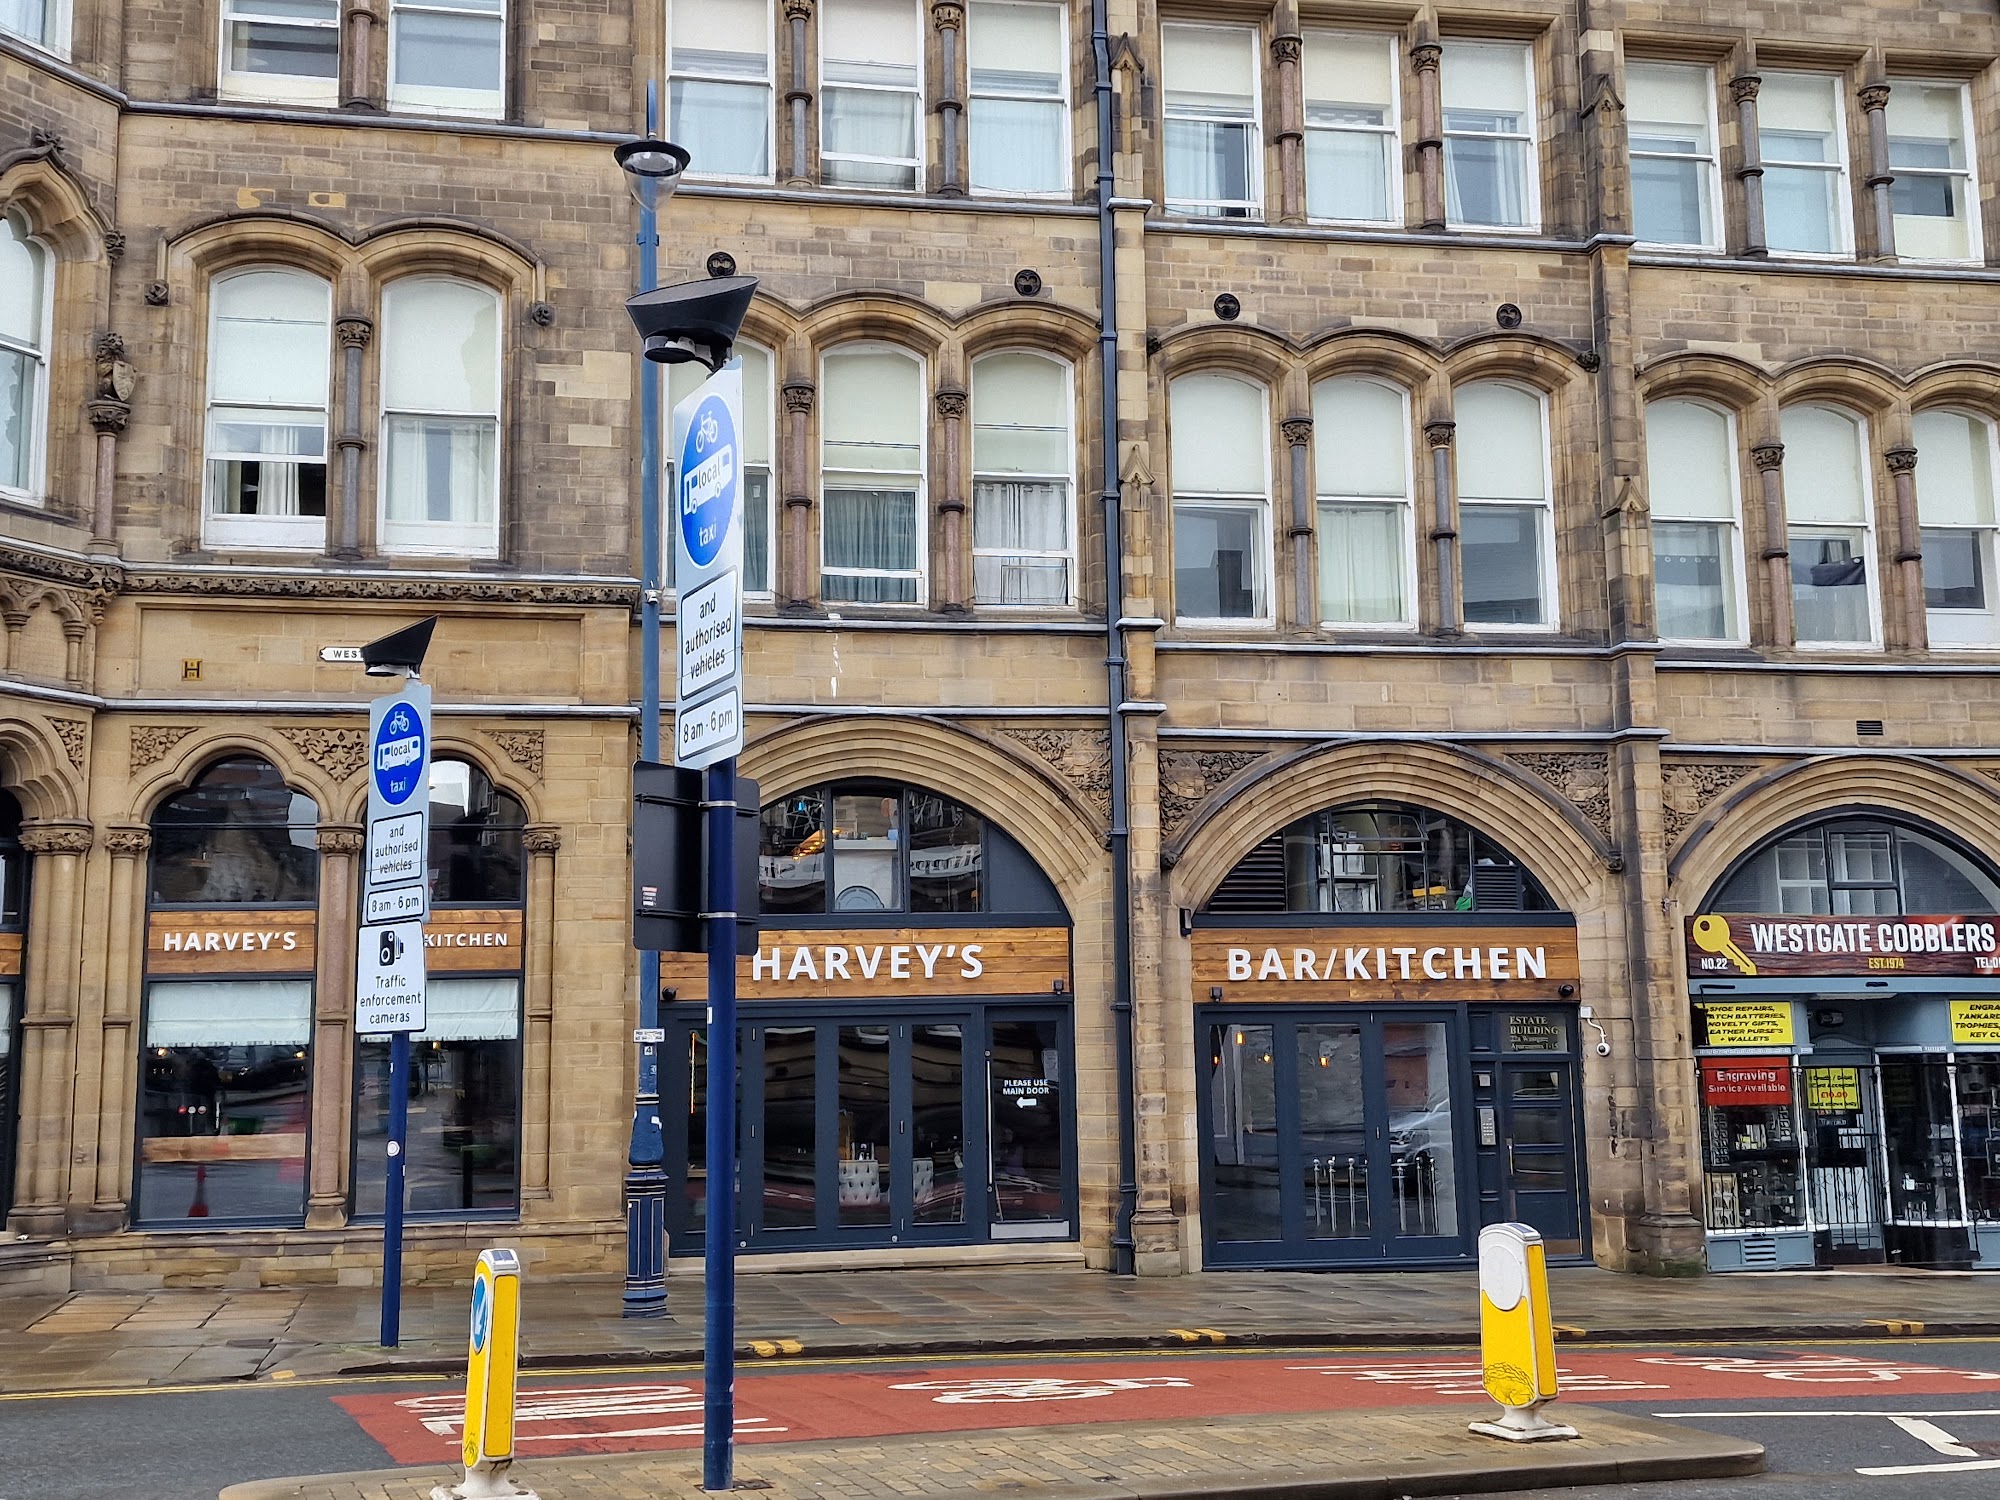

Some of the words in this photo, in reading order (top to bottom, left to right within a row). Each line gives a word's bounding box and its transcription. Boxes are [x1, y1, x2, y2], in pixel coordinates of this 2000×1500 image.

[698, 457, 721, 486] local
[699, 525, 717, 547] taxi
[699, 592, 717, 618] and
[684, 612, 733, 655] authorised
[689, 647, 726, 680] vehicles
[682, 724, 690, 743] 8
[690, 723, 706, 740] am
[710, 710, 717, 732] 6
[717, 708, 734, 734] pm
[390, 744, 411, 756] local
[390, 777, 406, 793] taxi
[389, 823, 405, 838] and
[375, 838, 418, 859] authorised
[379, 858, 413, 875] vehicles
[371, 899, 378, 913] 8
[378, 900, 392, 912] am
[397, 896, 404, 909] 6
[404, 896, 420, 911] pm
[164, 932, 296, 952] HARVEY'S
[424, 932, 508, 947] KITCHEN
[1750, 923, 1873, 953] WESTGATE
[1878, 922, 1996, 953] COBBLERS
[752, 943, 985, 982] HARVEY'S
[1227, 945, 1547, 982] BAR/KITCHEN
[1701, 957, 1728, 970] NO.22
[1868, 957, 1905, 969] EST.1974
[375, 975, 406, 988] Traffic
[360, 992, 421, 1008] enforcement
[369, 1011, 410, 1024] cameras
[1509, 1015, 1548, 1025] ESTATE
[1509, 1025, 1559, 1035] BUILDING
[1003, 1078, 1032, 1088] PLEASE
[1033, 1078, 1049, 1087] USE
[1717, 1069, 1777, 1084] Engraving
[1002, 1087, 1025, 1095] MAIN
[1026, 1086, 1050, 1095] DOOR
[1708, 1084, 1743, 1093] Service
[1744, 1082, 1787, 1092] Available
